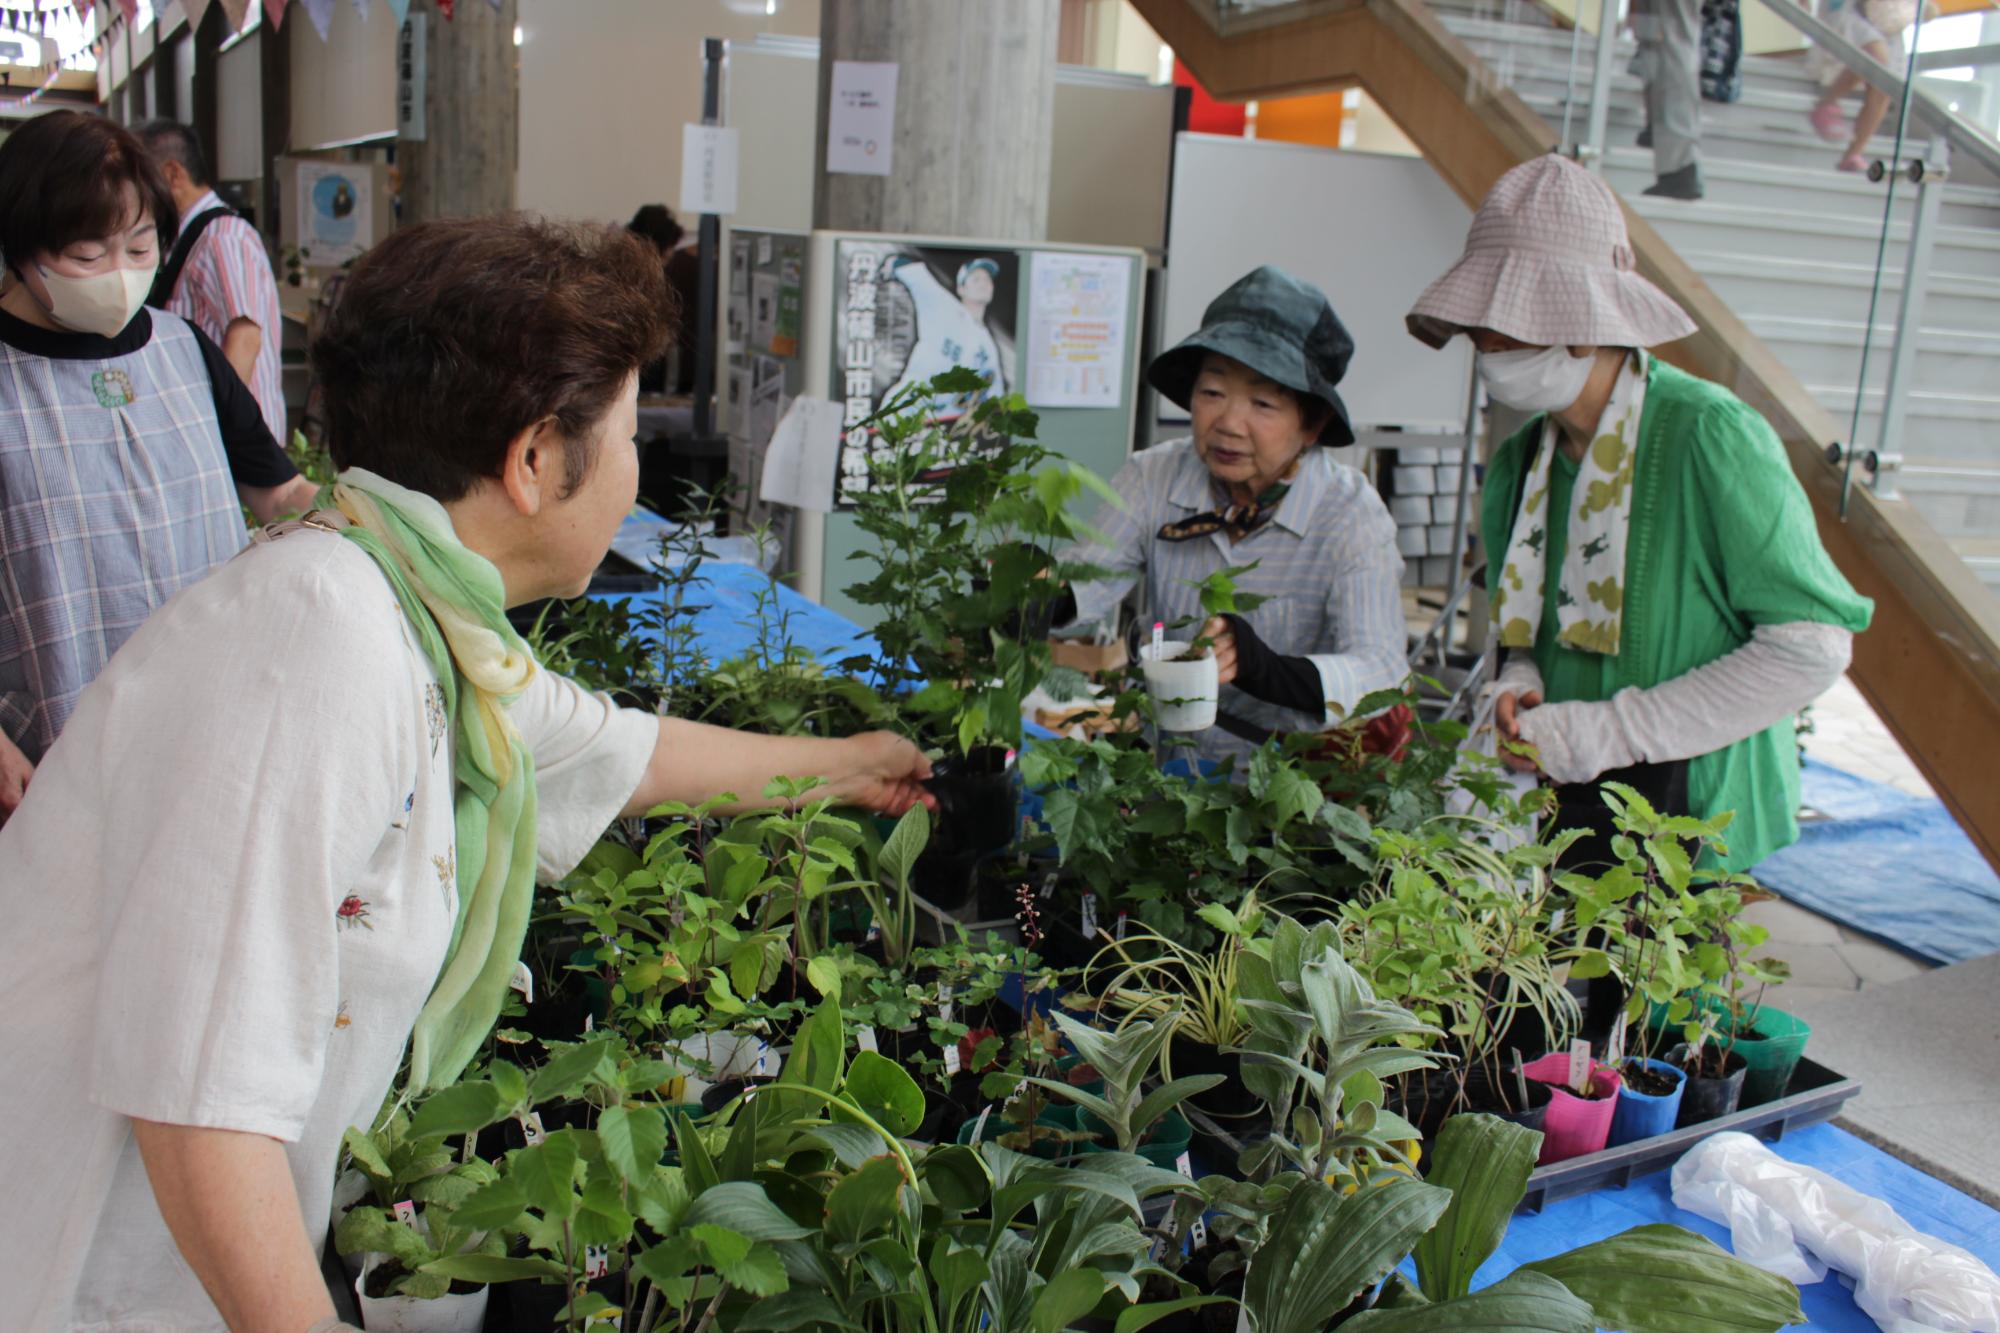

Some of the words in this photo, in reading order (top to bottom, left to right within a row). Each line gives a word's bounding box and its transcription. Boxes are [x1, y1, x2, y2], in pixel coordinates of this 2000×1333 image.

[839, 252, 878, 504] 丹波篠山市民の希望
